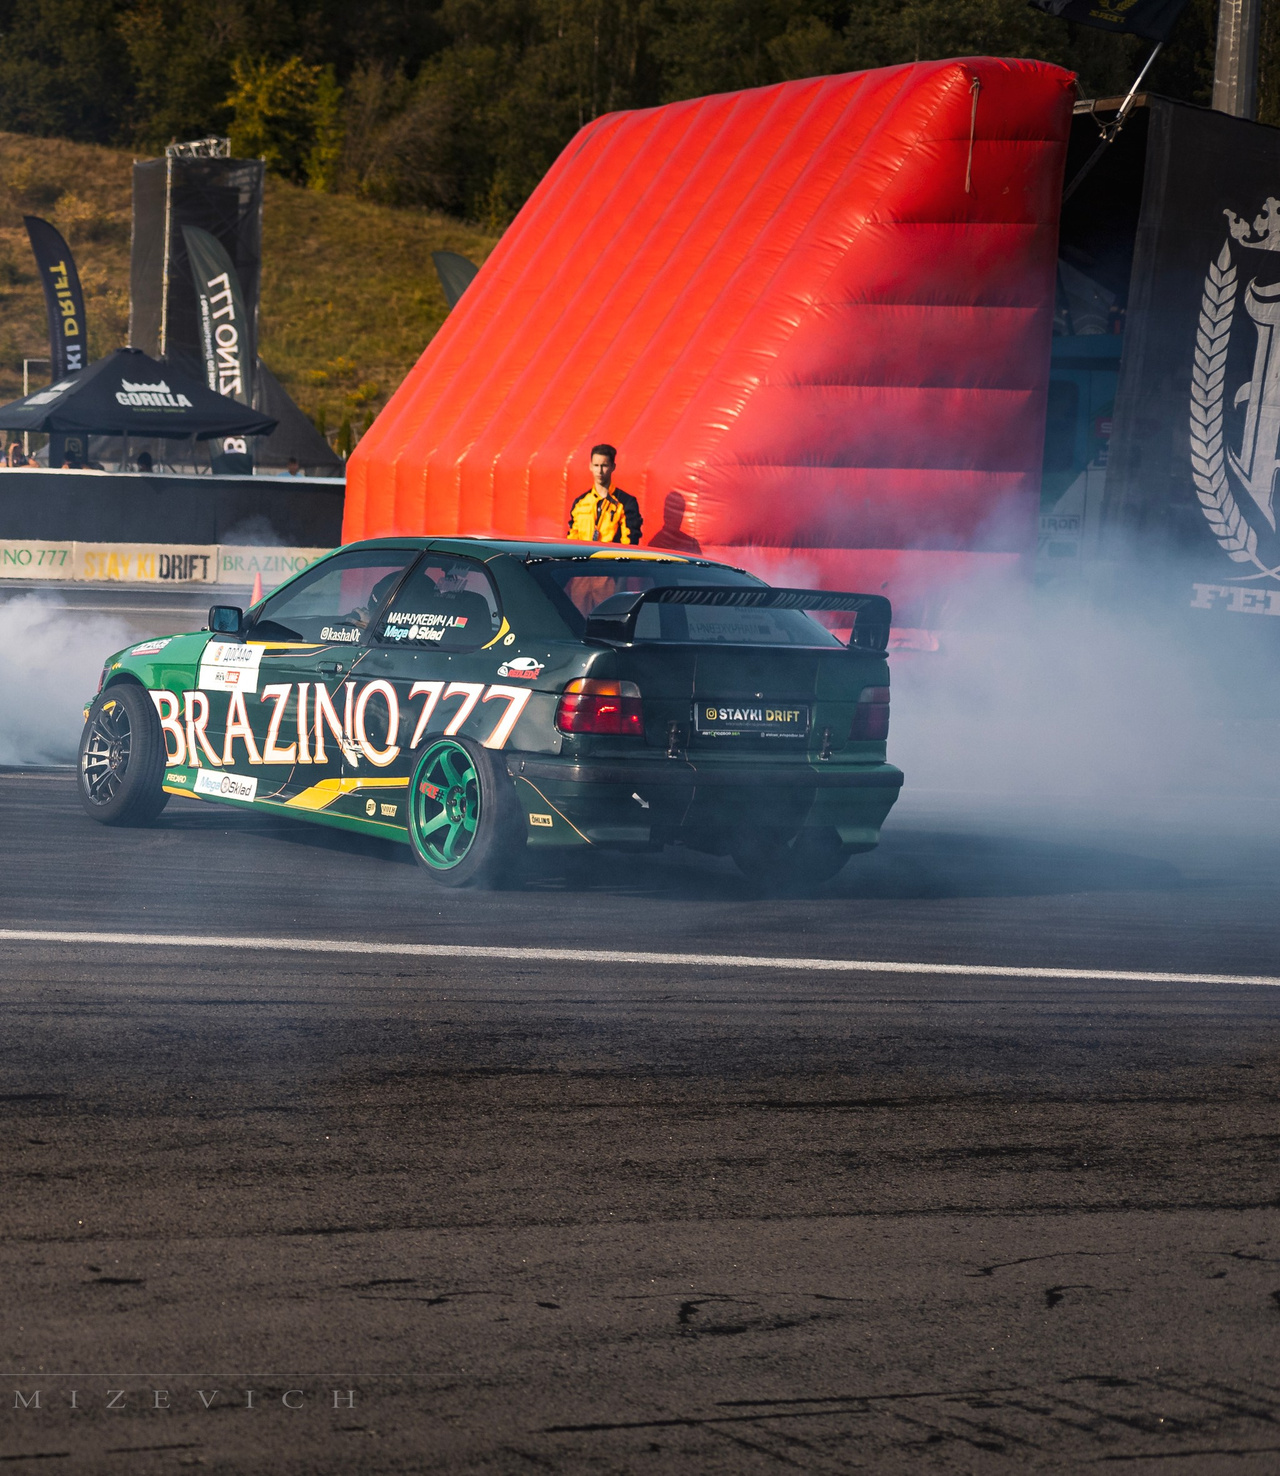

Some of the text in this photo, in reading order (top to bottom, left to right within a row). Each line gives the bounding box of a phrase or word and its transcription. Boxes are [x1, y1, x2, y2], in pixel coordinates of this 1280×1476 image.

[115, 392, 193, 408] GORILLA
[159, 554, 211, 580] DRIFT
[1190, 583, 1280, 616] FE
[383, 625, 445, 641] Mega Sklad
[719, 708, 800, 722] STAYKI DRIFT
[199, 776, 253, 796] Mega Sklad
